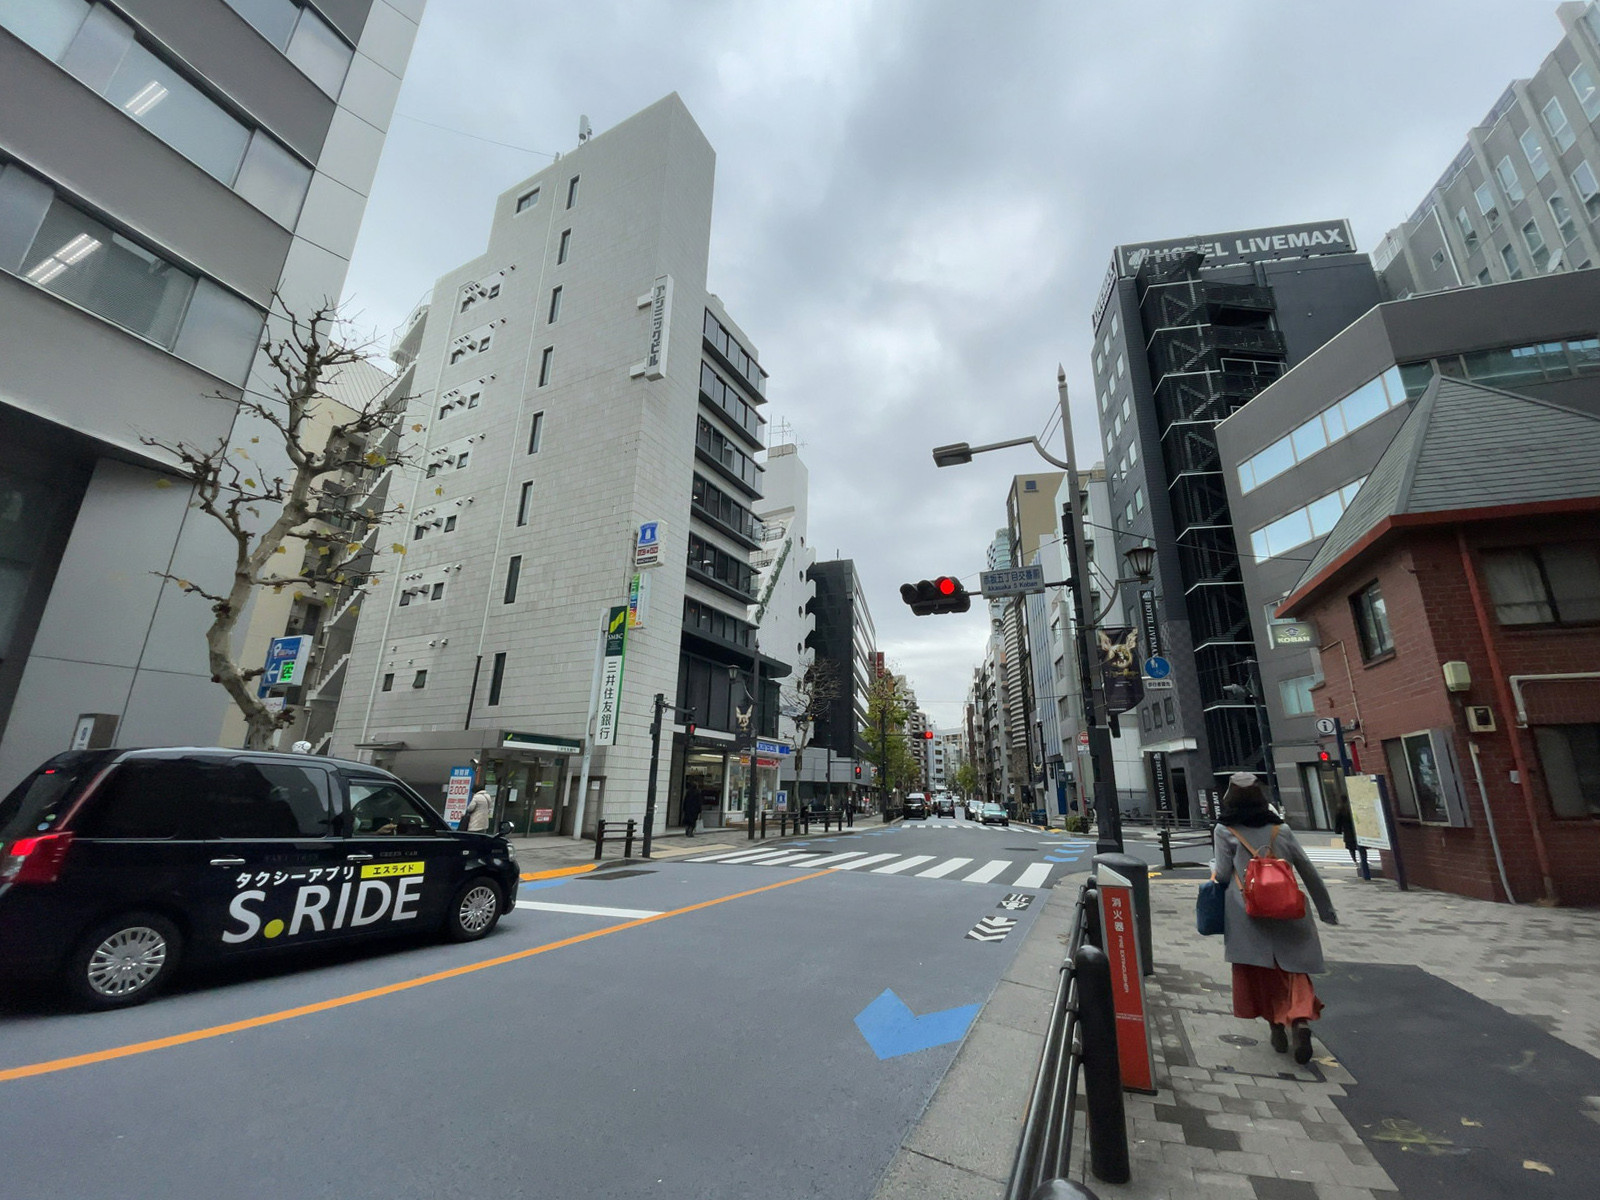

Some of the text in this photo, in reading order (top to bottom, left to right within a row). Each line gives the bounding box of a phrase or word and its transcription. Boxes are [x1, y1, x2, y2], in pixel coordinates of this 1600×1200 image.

[1145, 602, 1153, 623] HOTEL
[600, 661, 617, 740] 三井住友銀行
[236, 866, 354, 889] タクシーアプリ
[373, 864, 414, 875] エスライド
[1112, 897, 1124, 932] 消火器
